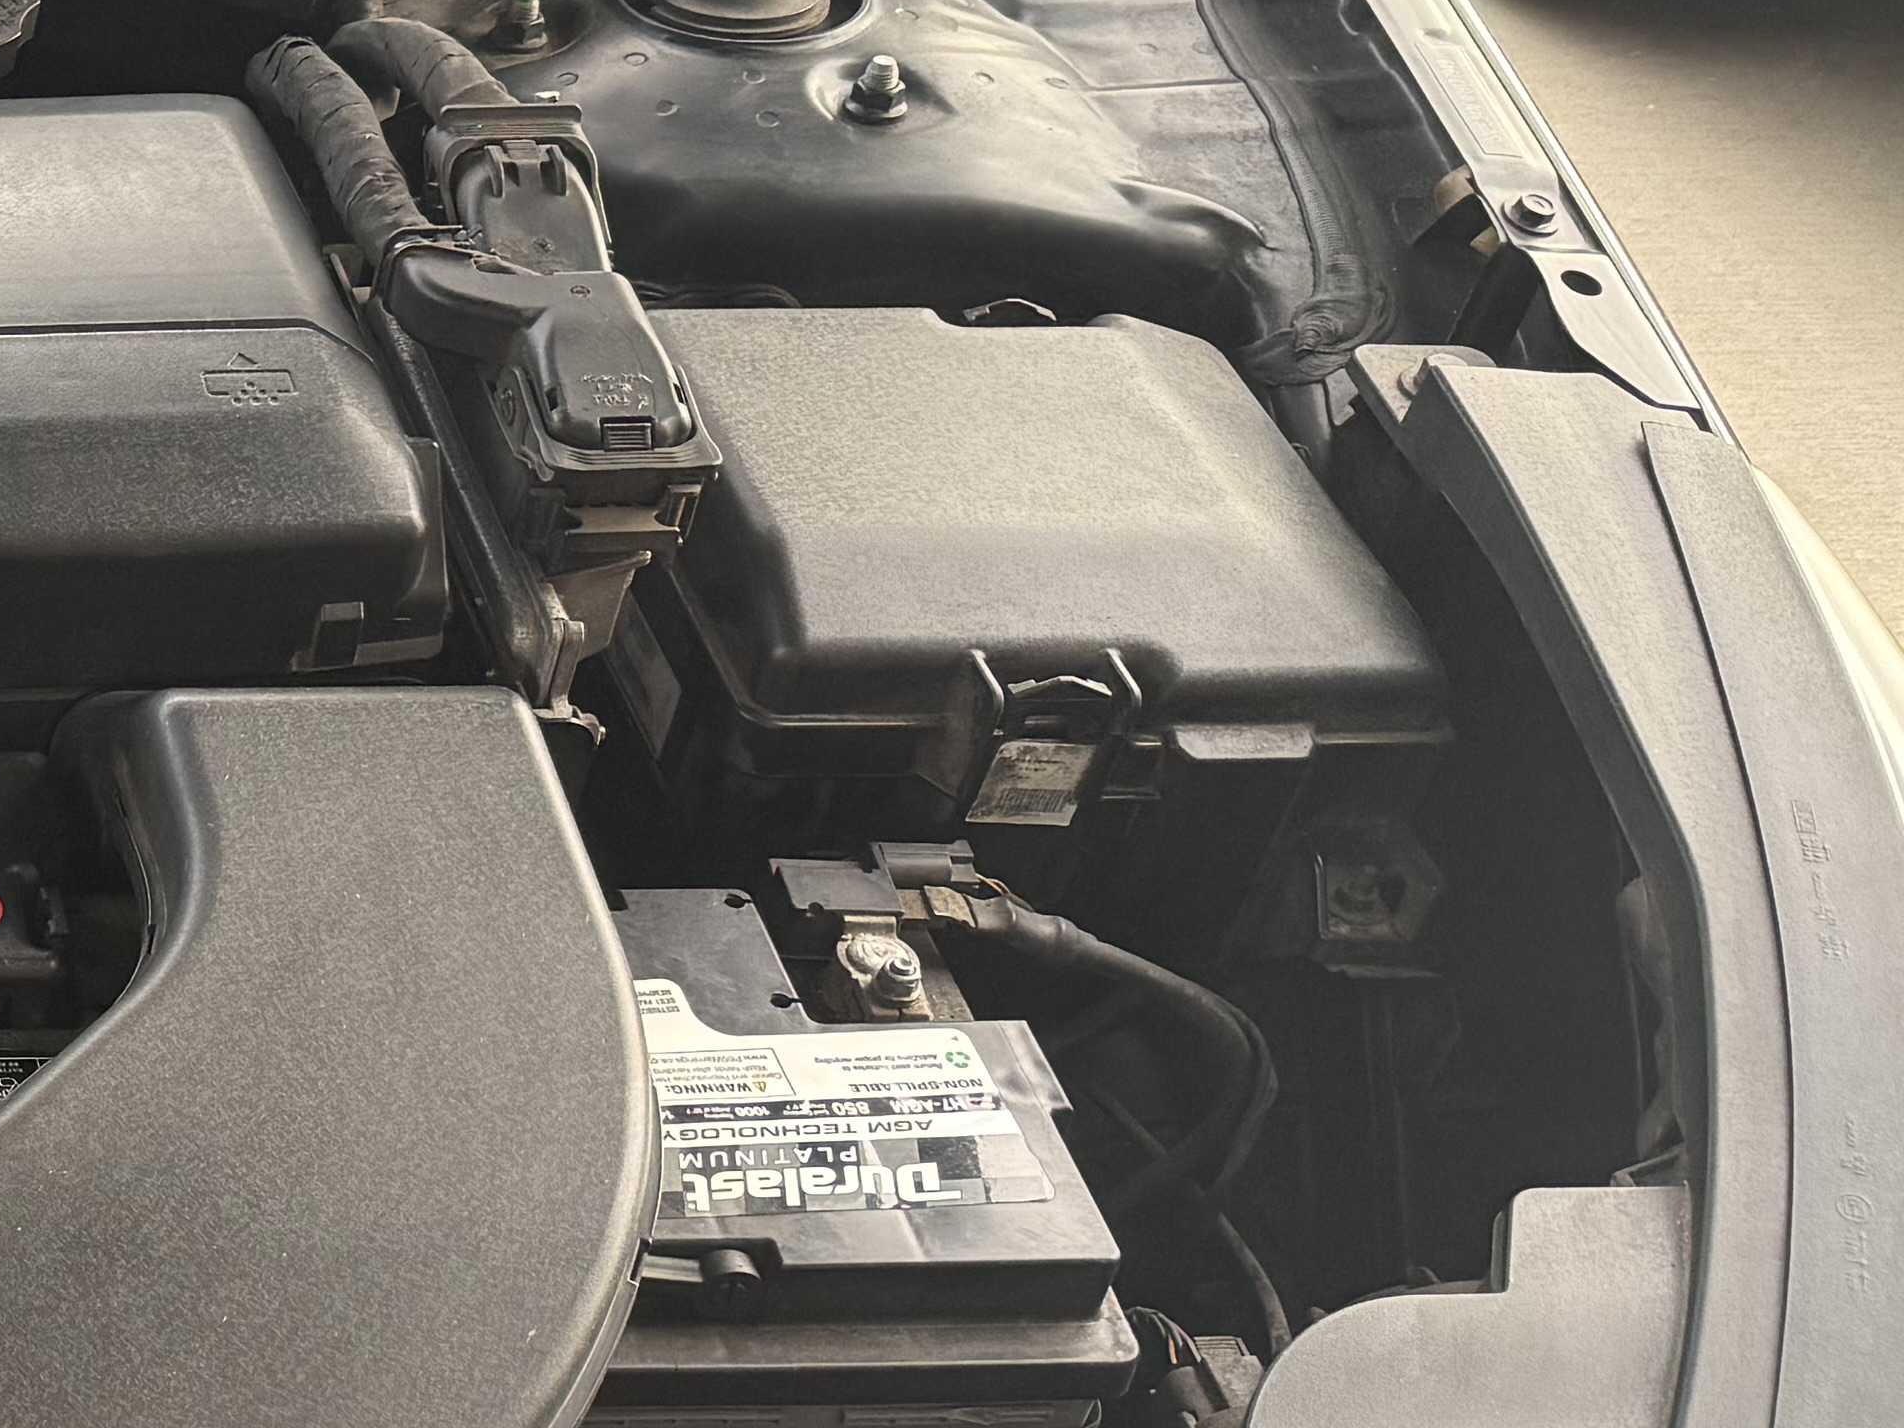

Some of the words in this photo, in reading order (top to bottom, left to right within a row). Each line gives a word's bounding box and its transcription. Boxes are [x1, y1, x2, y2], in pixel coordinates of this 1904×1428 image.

[665, 1082, 752, 1094] WARNING:
[848, 1078, 983, 1093] NON-SPILLABLE
[734, 1105, 770, 1118] 1000
[832, 1101, 871, 1116] 850
[663, 1123, 857, 1142] TECHNOLOGY
[867, 1119, 932, 1134] AGM
[678, 1145, 858, 1170] PLATINUM
[682, 1163, 962, 1211] Duralast
